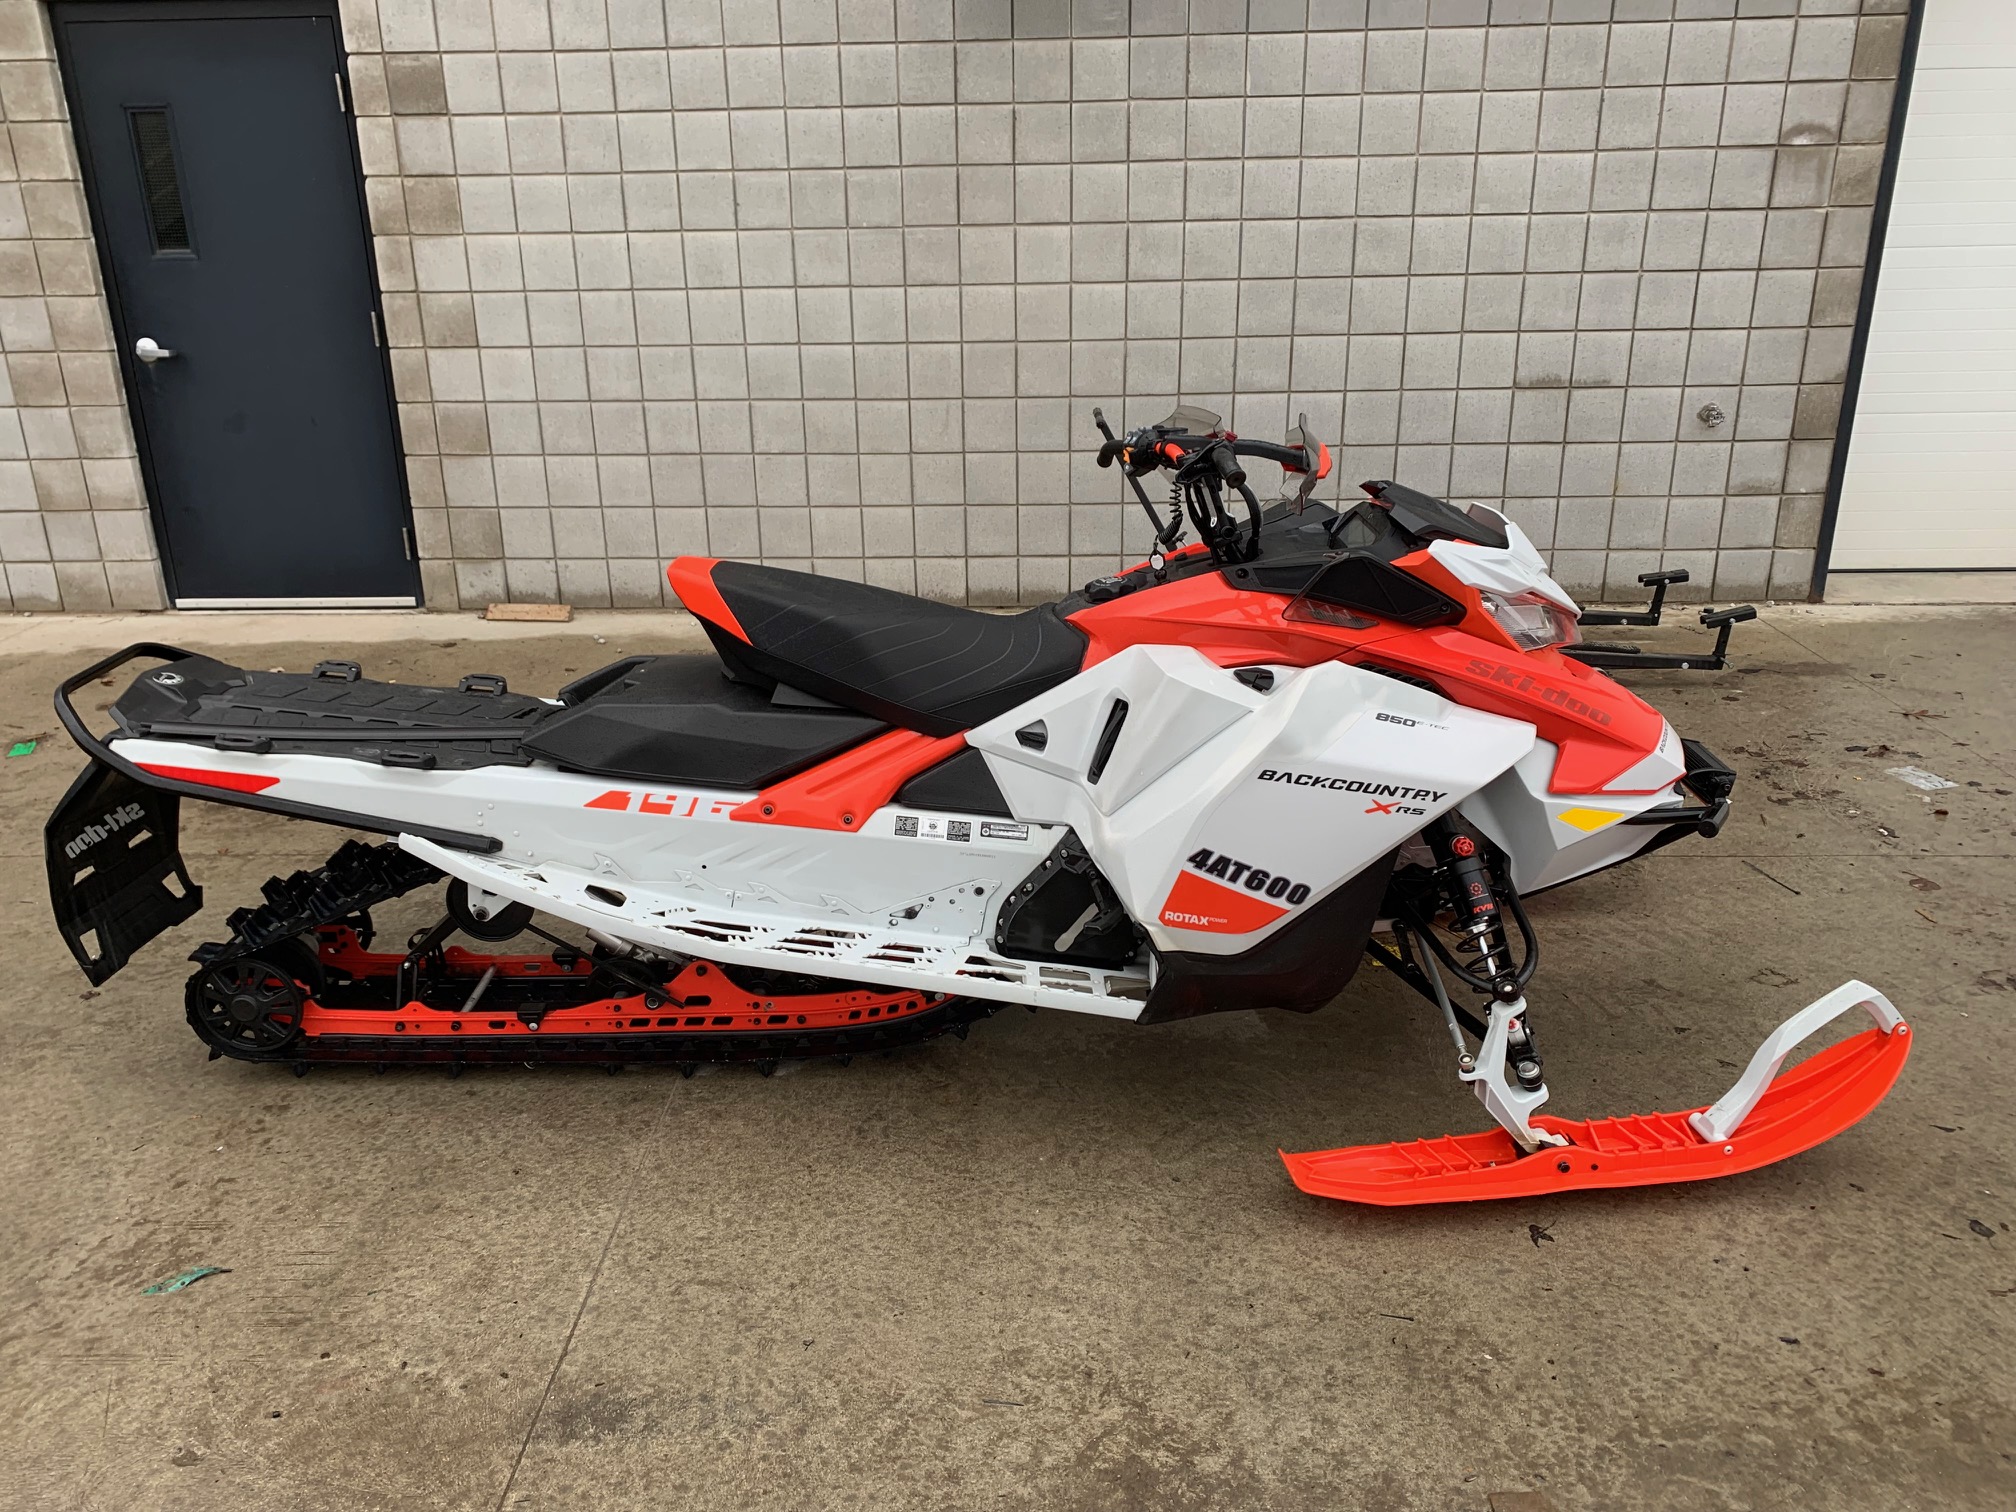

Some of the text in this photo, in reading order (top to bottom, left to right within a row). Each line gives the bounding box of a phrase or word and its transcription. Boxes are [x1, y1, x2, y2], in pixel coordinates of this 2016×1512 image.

[1375, 712, 1417, 728] 850
[1257, 769, 1448, 803] BACKCOUNTRY
[1186, 847, 1312, 906] 4AT600
[1164, 911, 1210, 926] ROTAX
